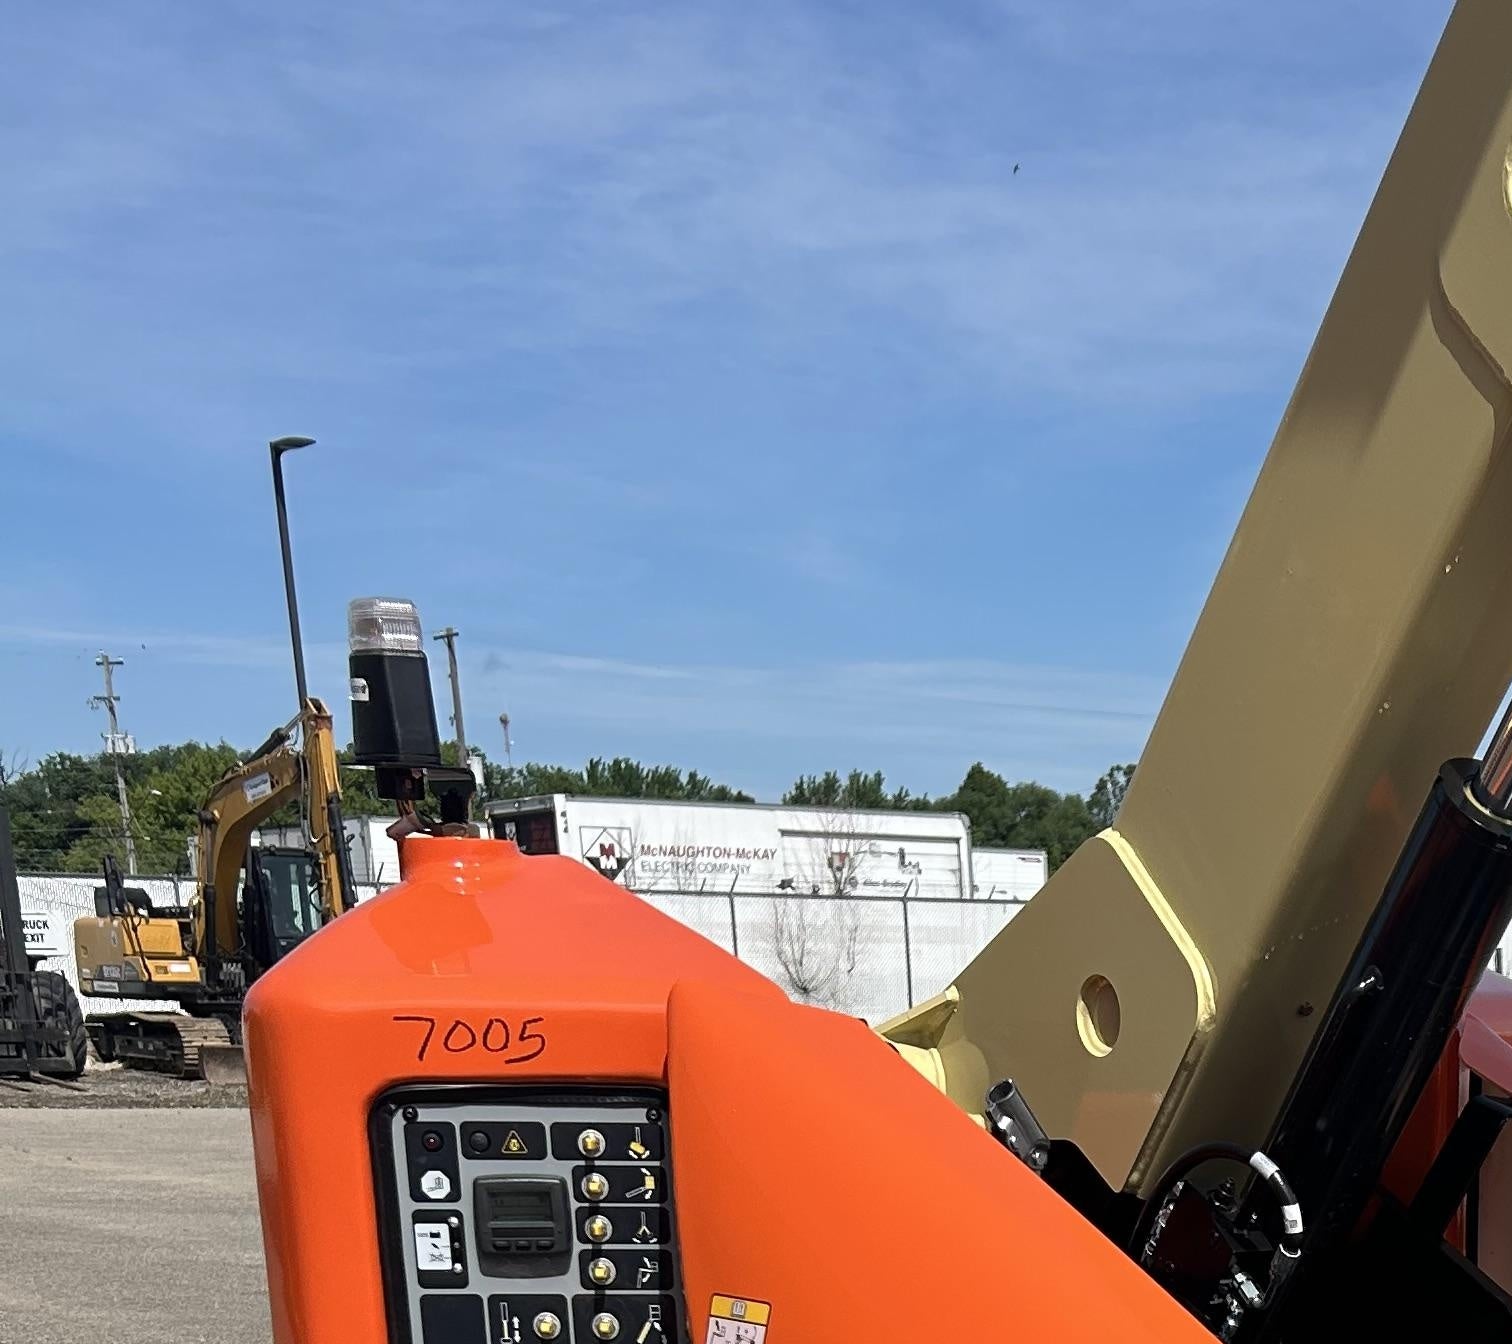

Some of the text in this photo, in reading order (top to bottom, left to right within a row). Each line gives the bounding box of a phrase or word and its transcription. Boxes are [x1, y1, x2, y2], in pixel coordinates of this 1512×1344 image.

[640, 844, 777, 860] McNAUGHTON-McKAY
[641, 860, 751, 875] ELECTRIC COMPANY
[22, 920, 49, 930] RUCK
[393, 1016, 546, 1065] 7005
